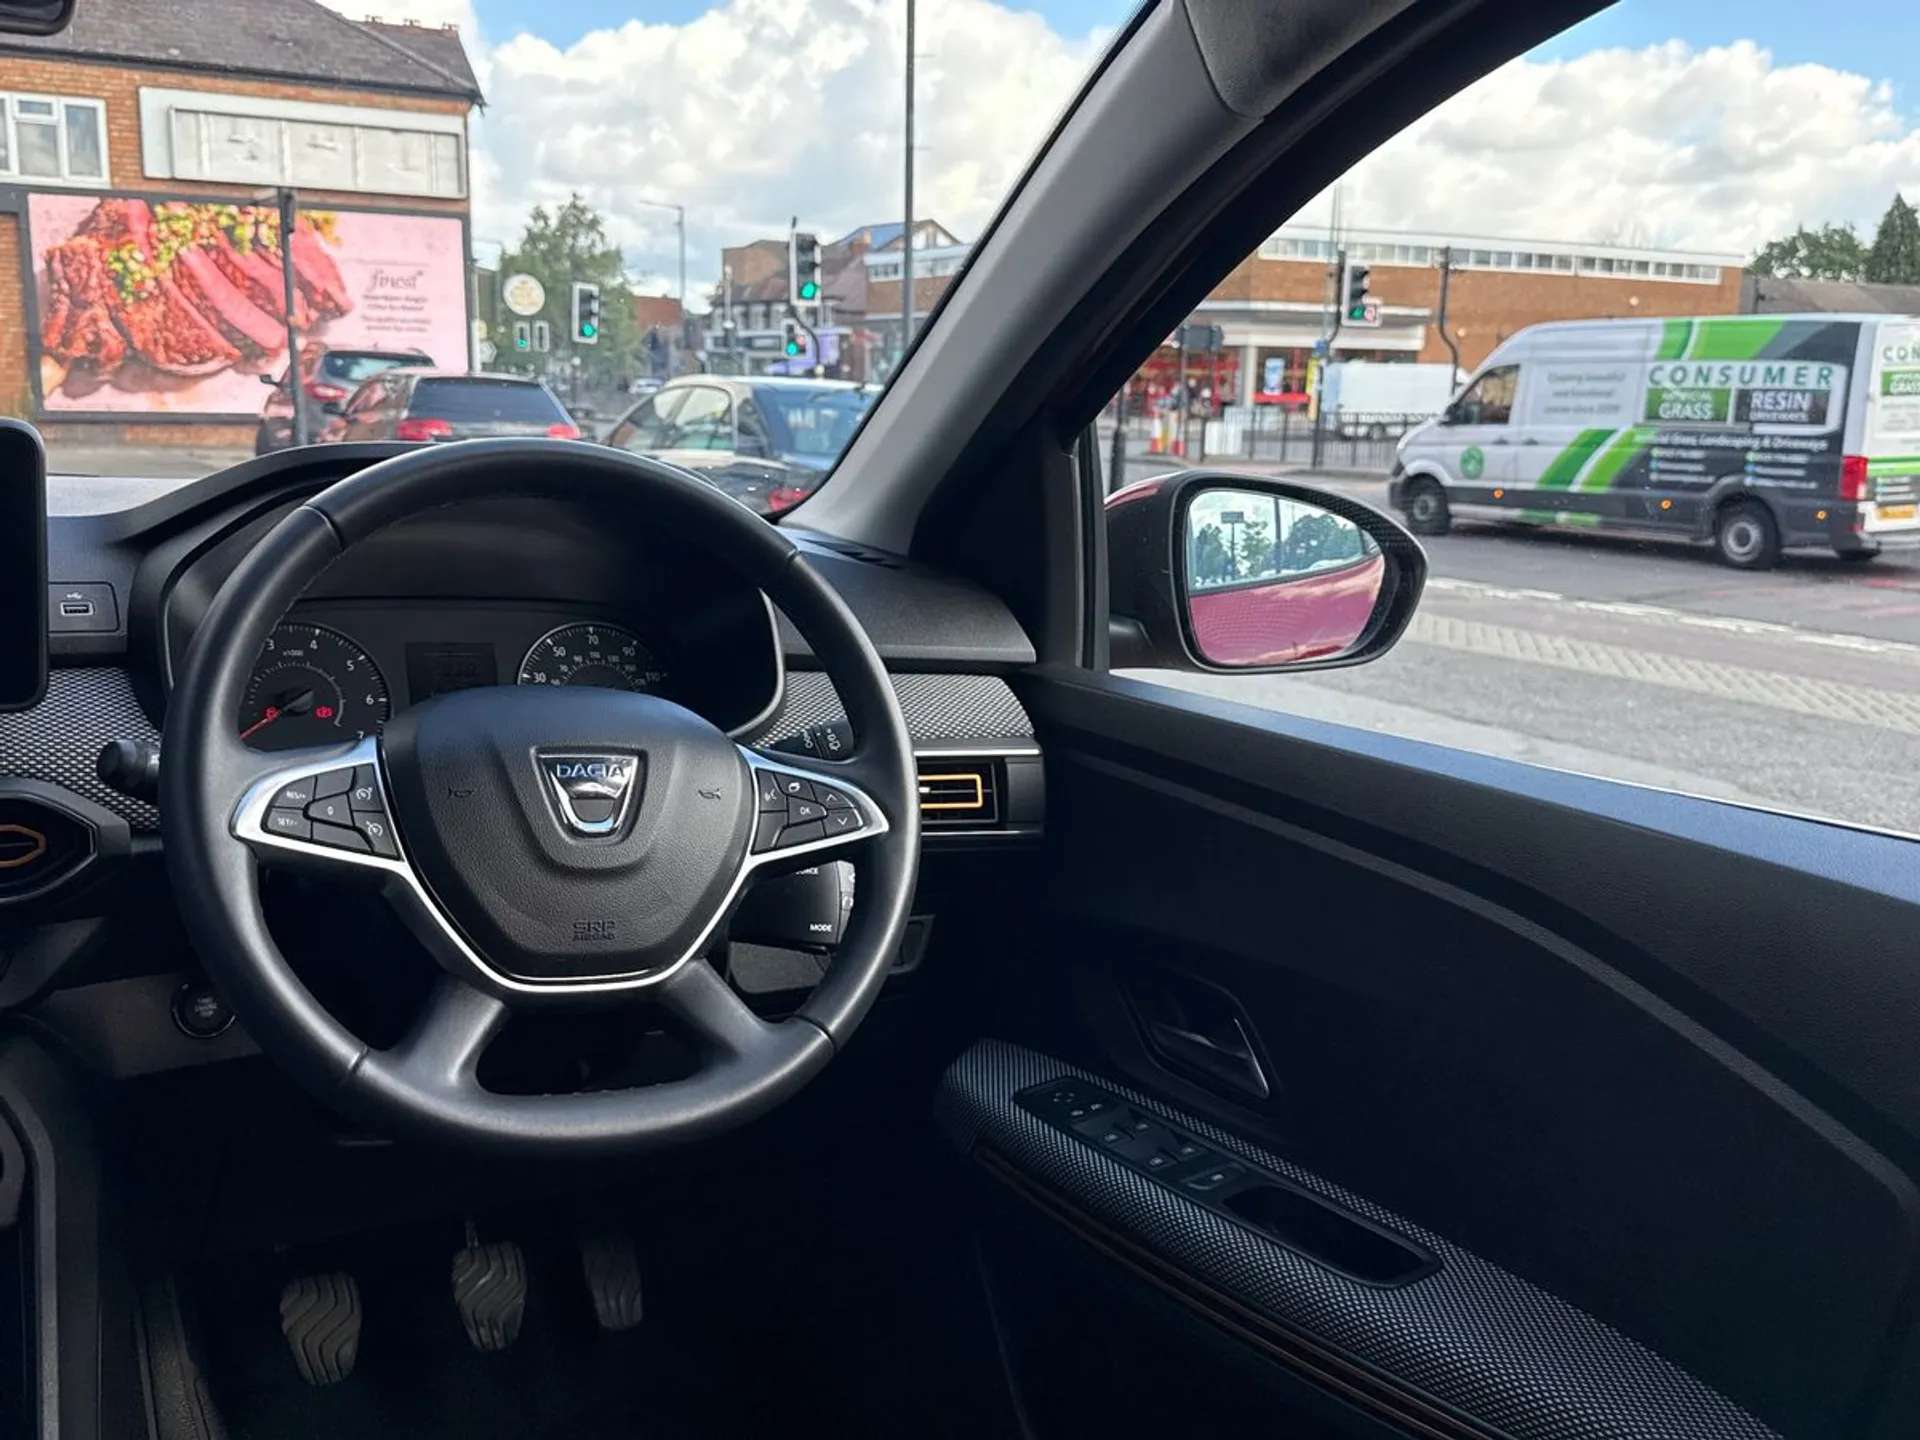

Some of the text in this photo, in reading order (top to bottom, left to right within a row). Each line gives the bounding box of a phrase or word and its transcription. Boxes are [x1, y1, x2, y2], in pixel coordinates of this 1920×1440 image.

[1649, 365, 1834, 386] CONSUMER
[1750, 391, 1811, 411] RESIN
[1659, 402, 1713, 420] GRASS
[266, 638, 275, 650] 3
[310, 639, 318, 650] 4
[587, 634, 600, 645] 70
[553, 646, 566, 657] 50
[622, 646, 636, 657] 90
[347, 660, 355, 671] 5
[533, 671, 547, 684] 30
[366, 694, 375, 705] 6
[557, 763, 625, 778] DACIA
[800, 806, 812, 815] OK
[810, 923, 832, 932] MODE
